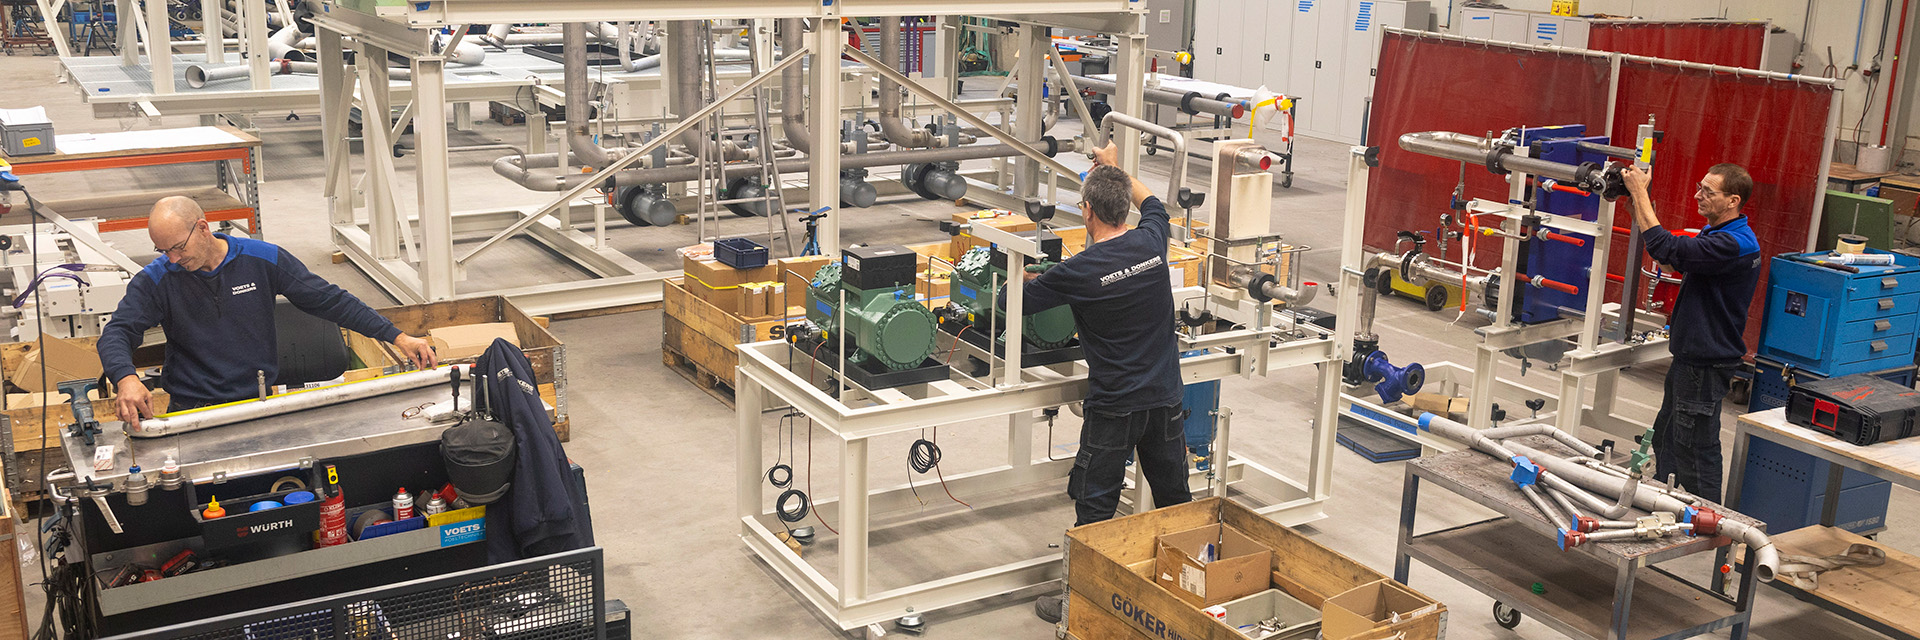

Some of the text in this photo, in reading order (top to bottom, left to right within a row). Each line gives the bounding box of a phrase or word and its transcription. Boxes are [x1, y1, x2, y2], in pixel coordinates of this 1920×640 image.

[1100, 270, 1123, 282] VOETS
[1131, 256, 1161, 271] DONKERS
[250, 519, 293, 534] WÜRTH
[444, 523, 480, 536] VOETS
[1111, 592, 1166, 640] GÖKER
